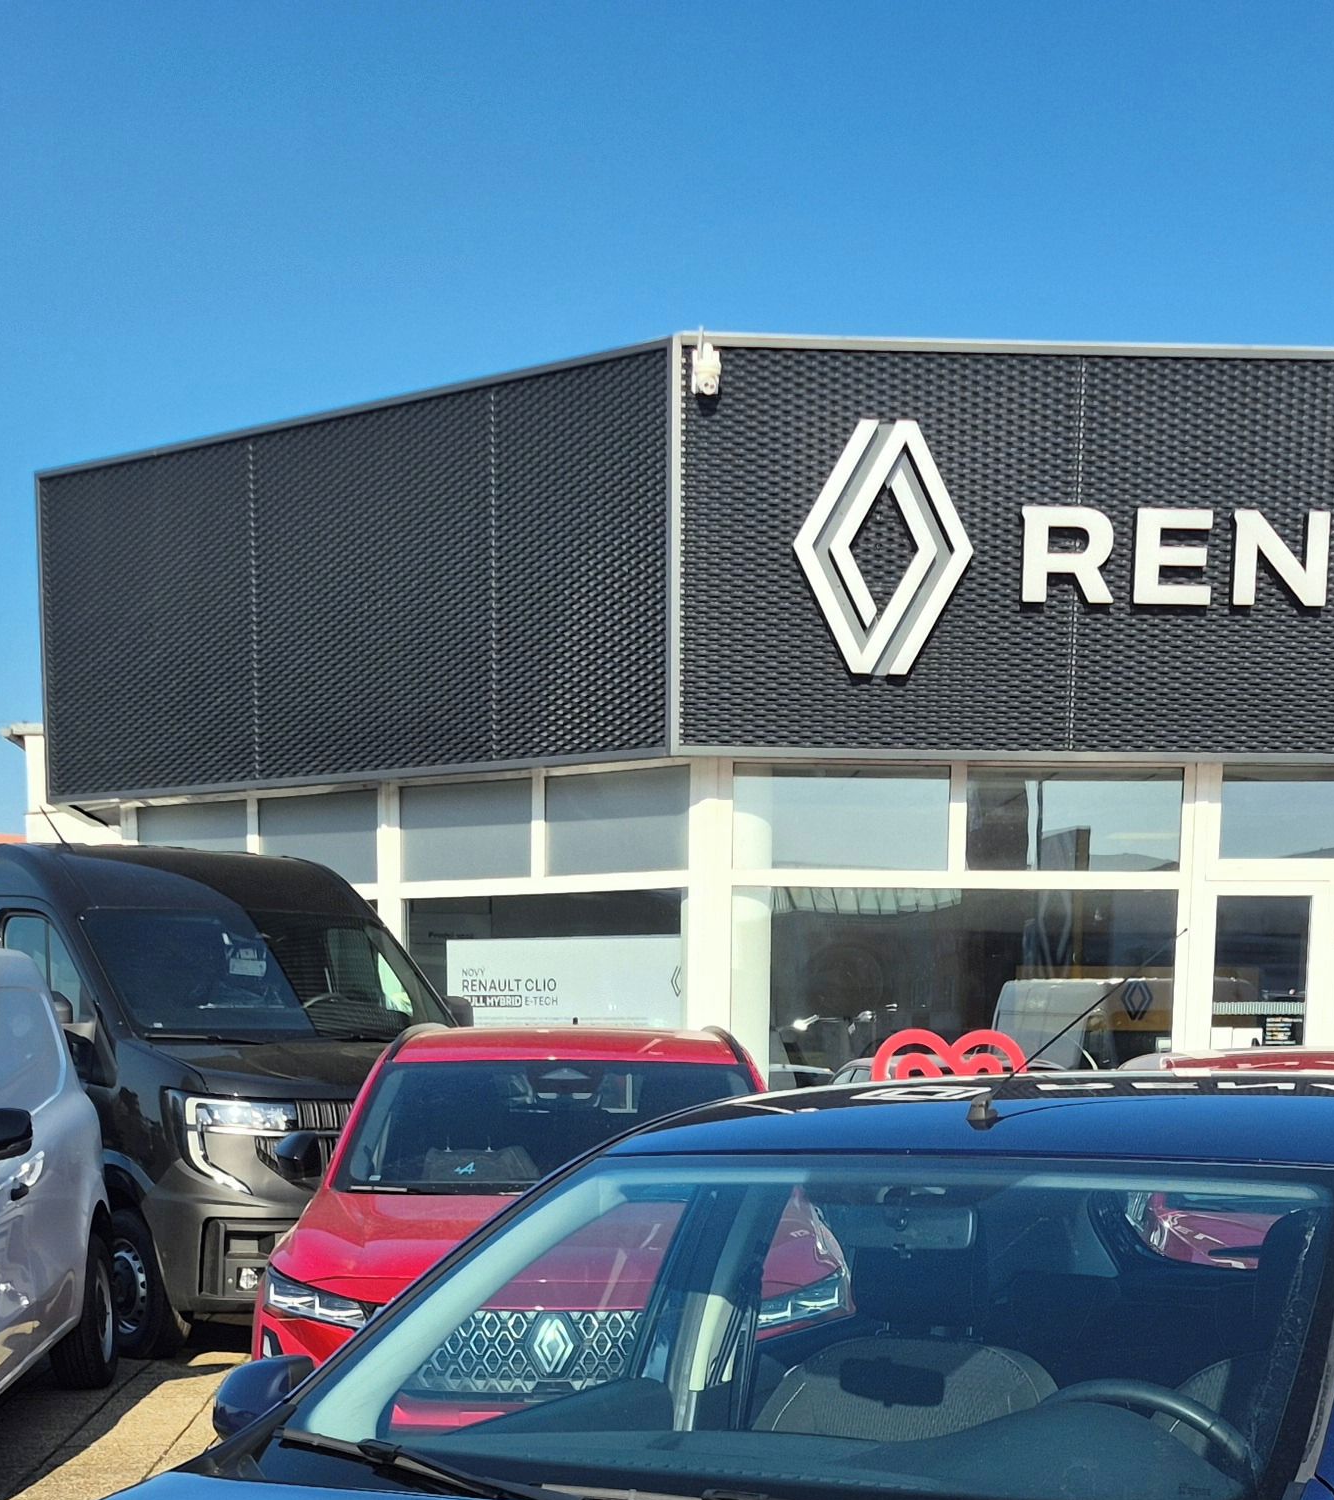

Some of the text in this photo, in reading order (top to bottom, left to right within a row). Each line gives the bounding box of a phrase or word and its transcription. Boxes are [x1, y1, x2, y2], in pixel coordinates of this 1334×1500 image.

[461, 978, 557, 993] RENAULT CLIO
[486, 996, 521, 1007] HYBRID
[524, 996, 558, 1006] E-TECH
